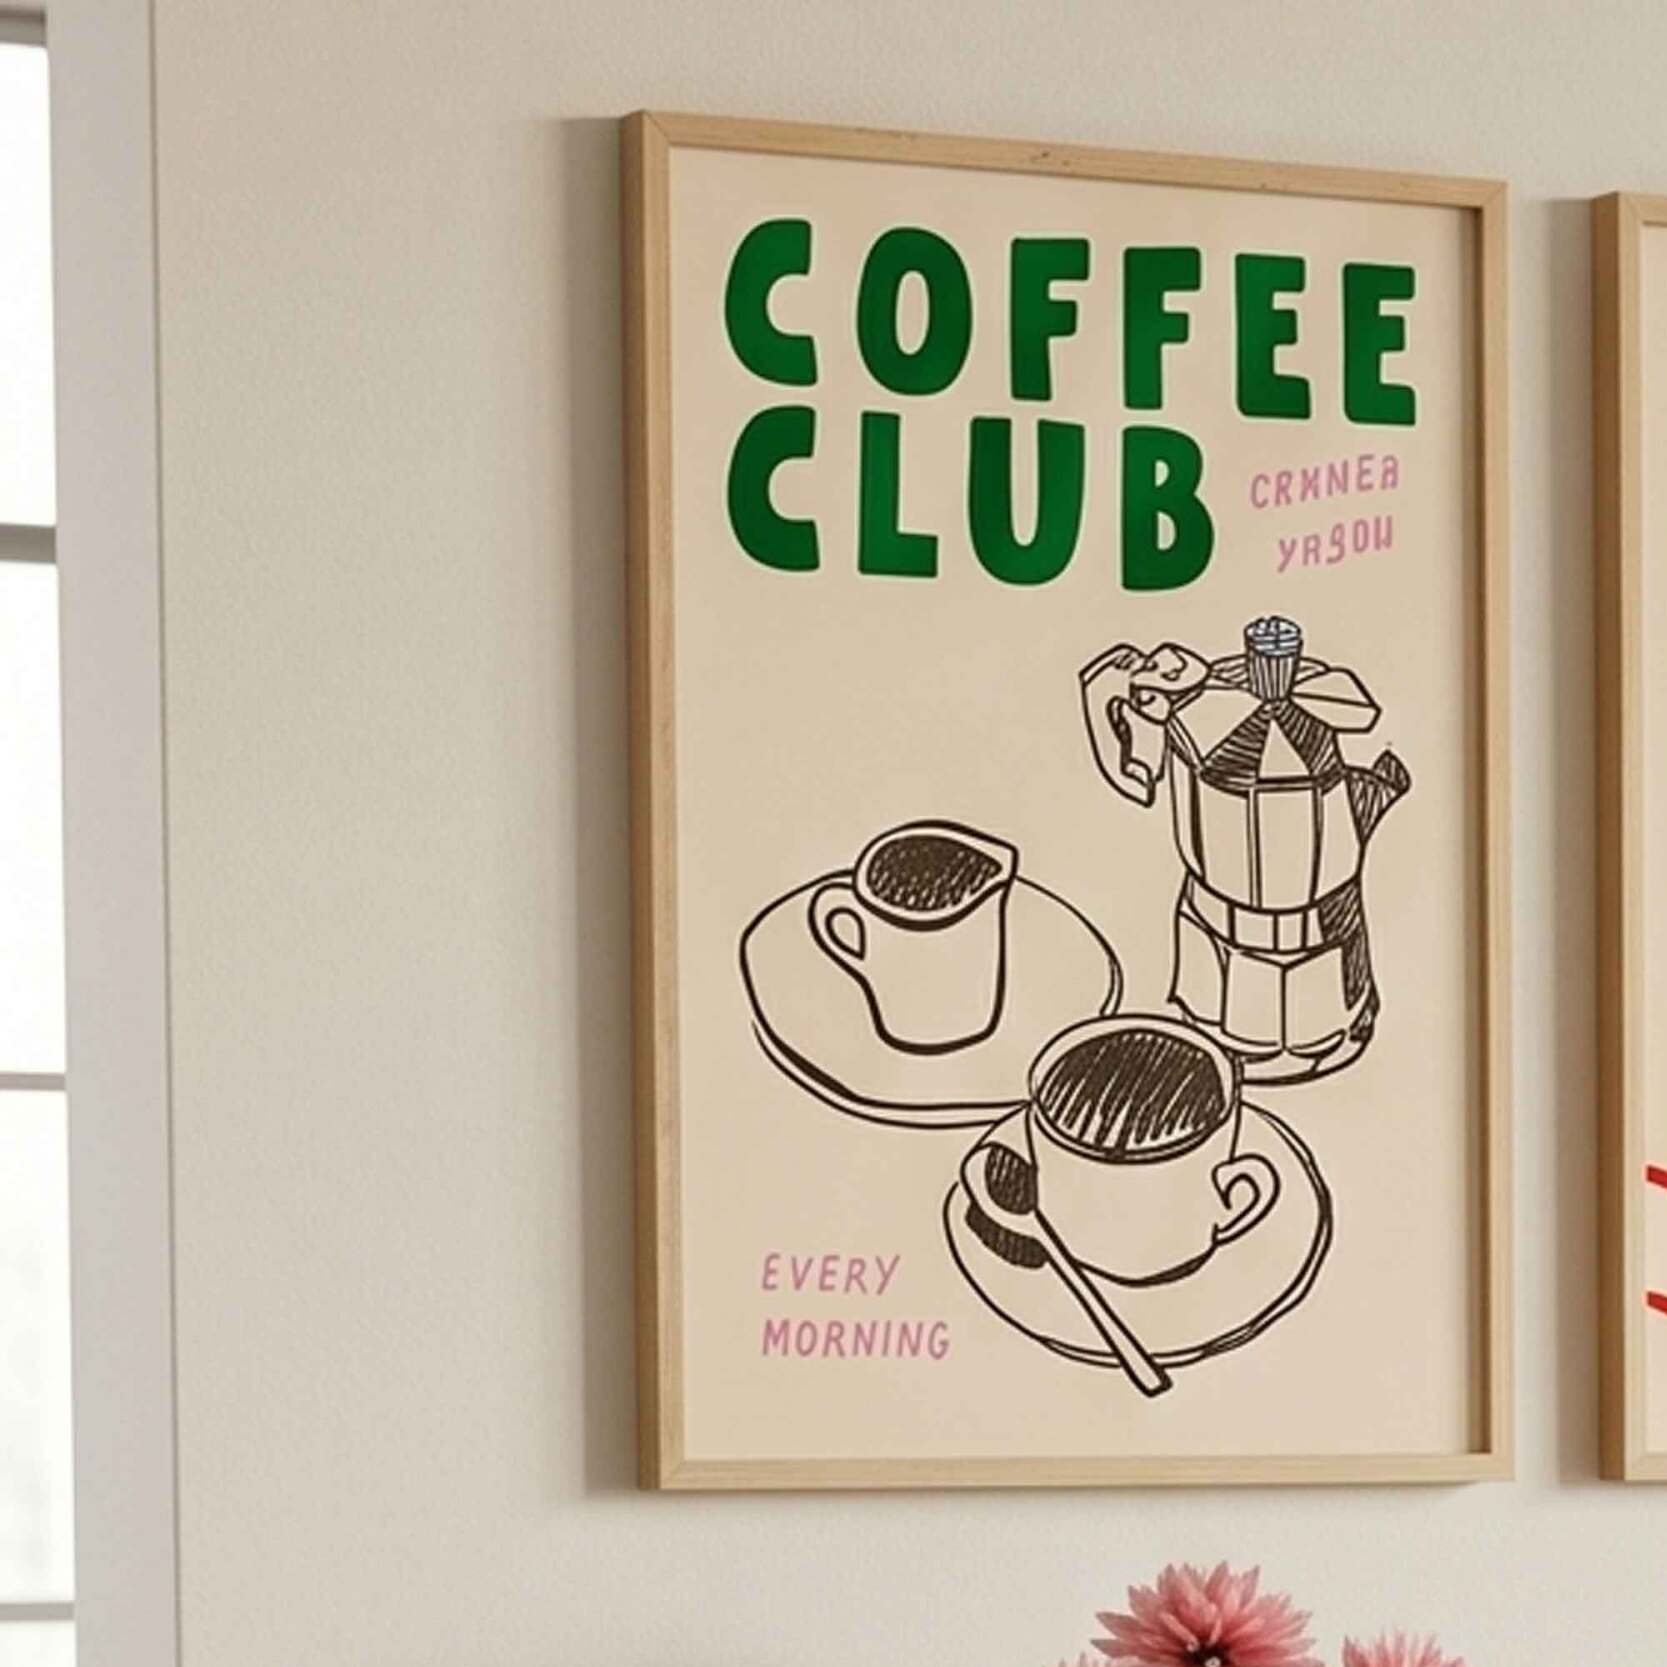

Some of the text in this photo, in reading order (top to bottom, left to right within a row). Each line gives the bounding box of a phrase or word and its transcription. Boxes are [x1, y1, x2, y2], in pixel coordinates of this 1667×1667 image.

[723, 218, 1417, 426] COFFEE
[726, 404, 1215, 592] CLUB
[761, 1252, 901, 1296] EVERY
[762, 1318, 949, 1361] MORNING
